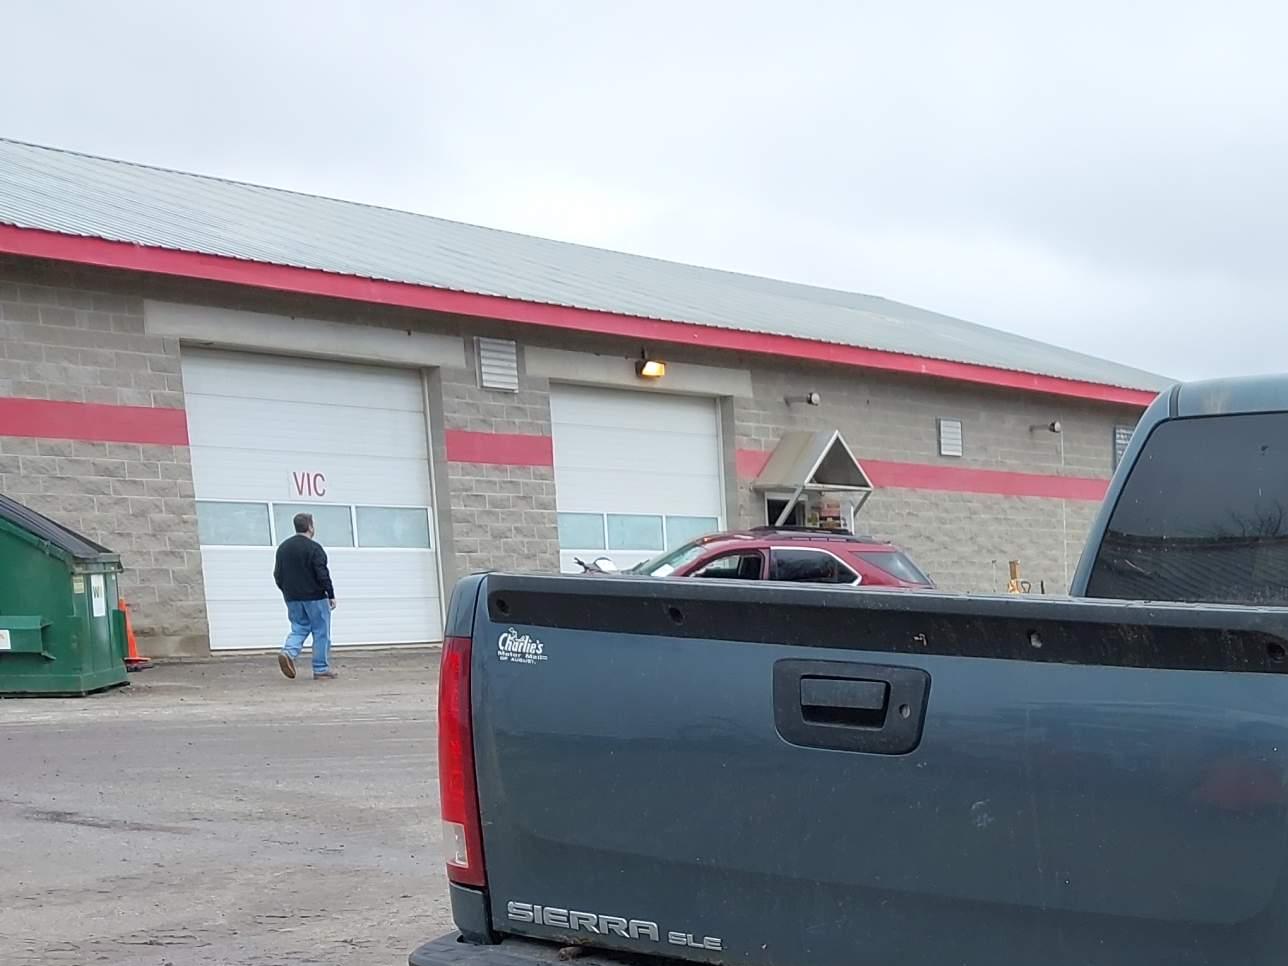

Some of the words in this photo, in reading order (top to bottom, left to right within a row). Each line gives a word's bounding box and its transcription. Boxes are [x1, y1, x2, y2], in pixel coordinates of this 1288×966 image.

[292, 471, 326, 497] VIC
[497, 650, 521, 658] Motor
[498, 632, 544, 654] Charlie's
[507, 900, 660, 942] SIERRA
[667, 931, 723, 951] SLE
